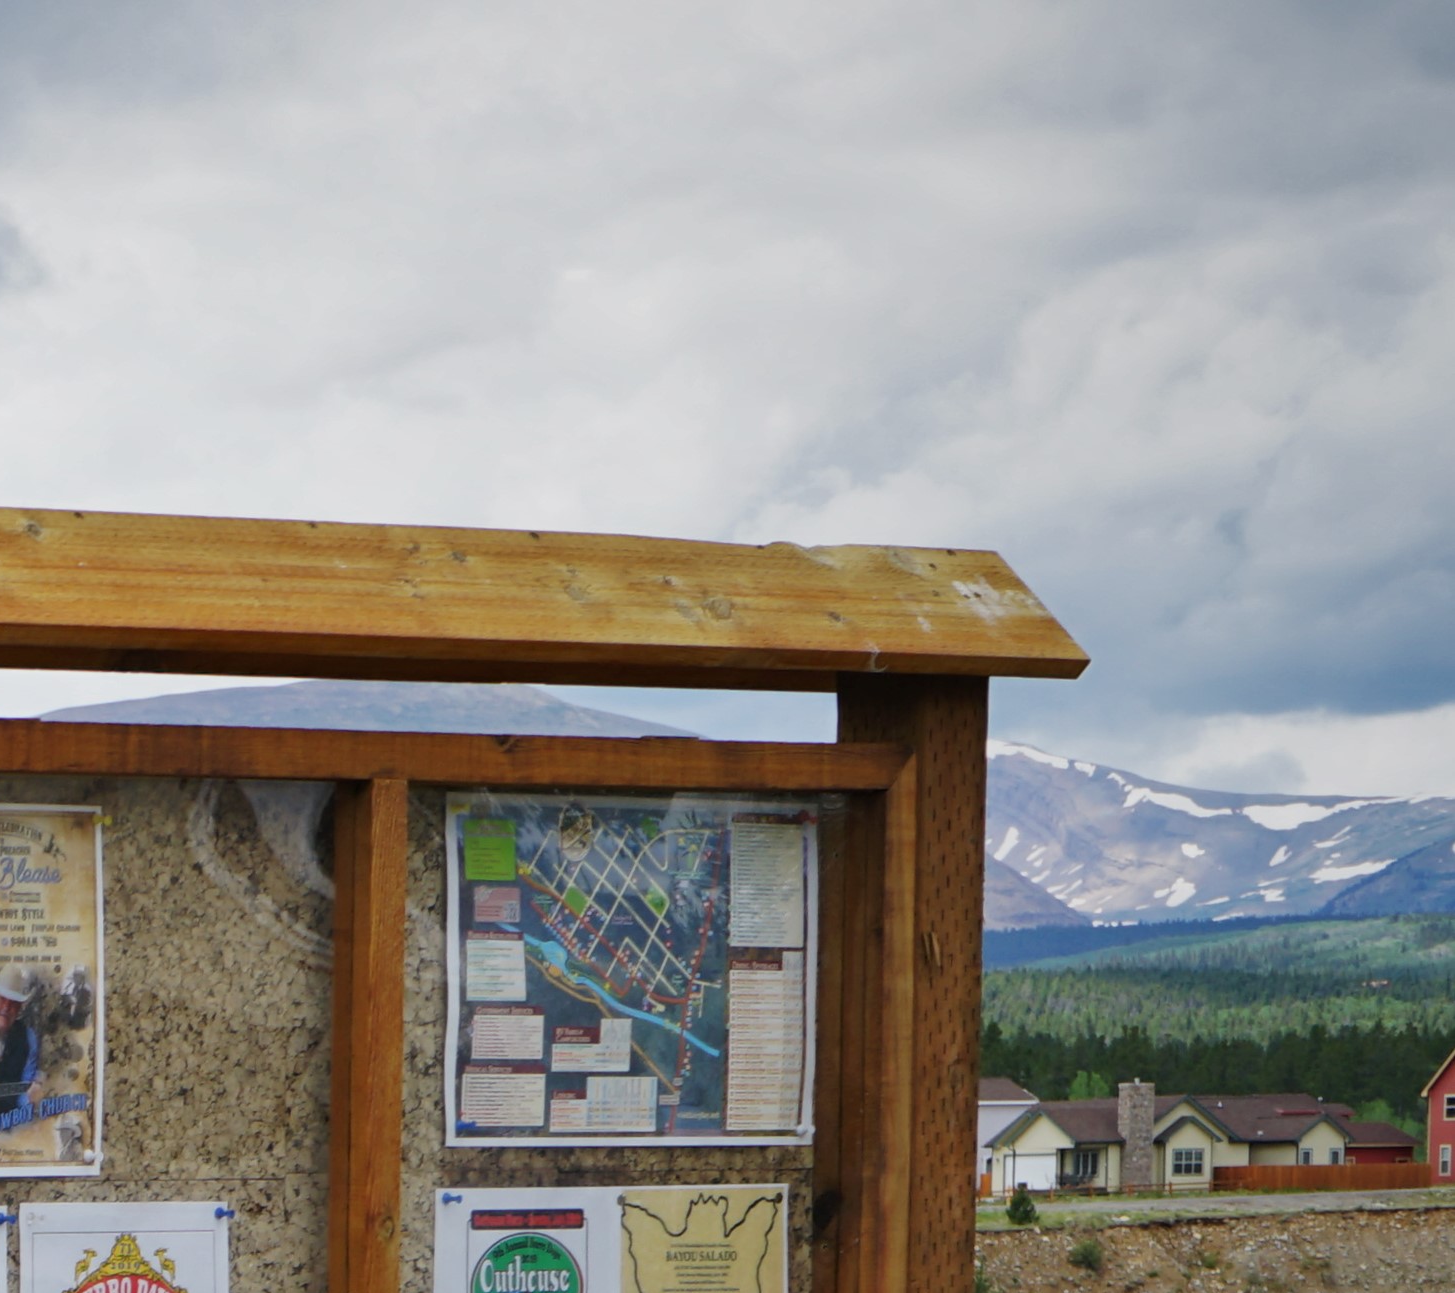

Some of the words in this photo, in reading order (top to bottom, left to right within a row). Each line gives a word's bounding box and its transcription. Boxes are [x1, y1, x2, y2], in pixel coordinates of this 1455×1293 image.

[38, 1093, 89, 1120] CHURCH
[699, 1251, 737, 1261] SALADO
[480, 1255, 571, 1293] Outhouse
